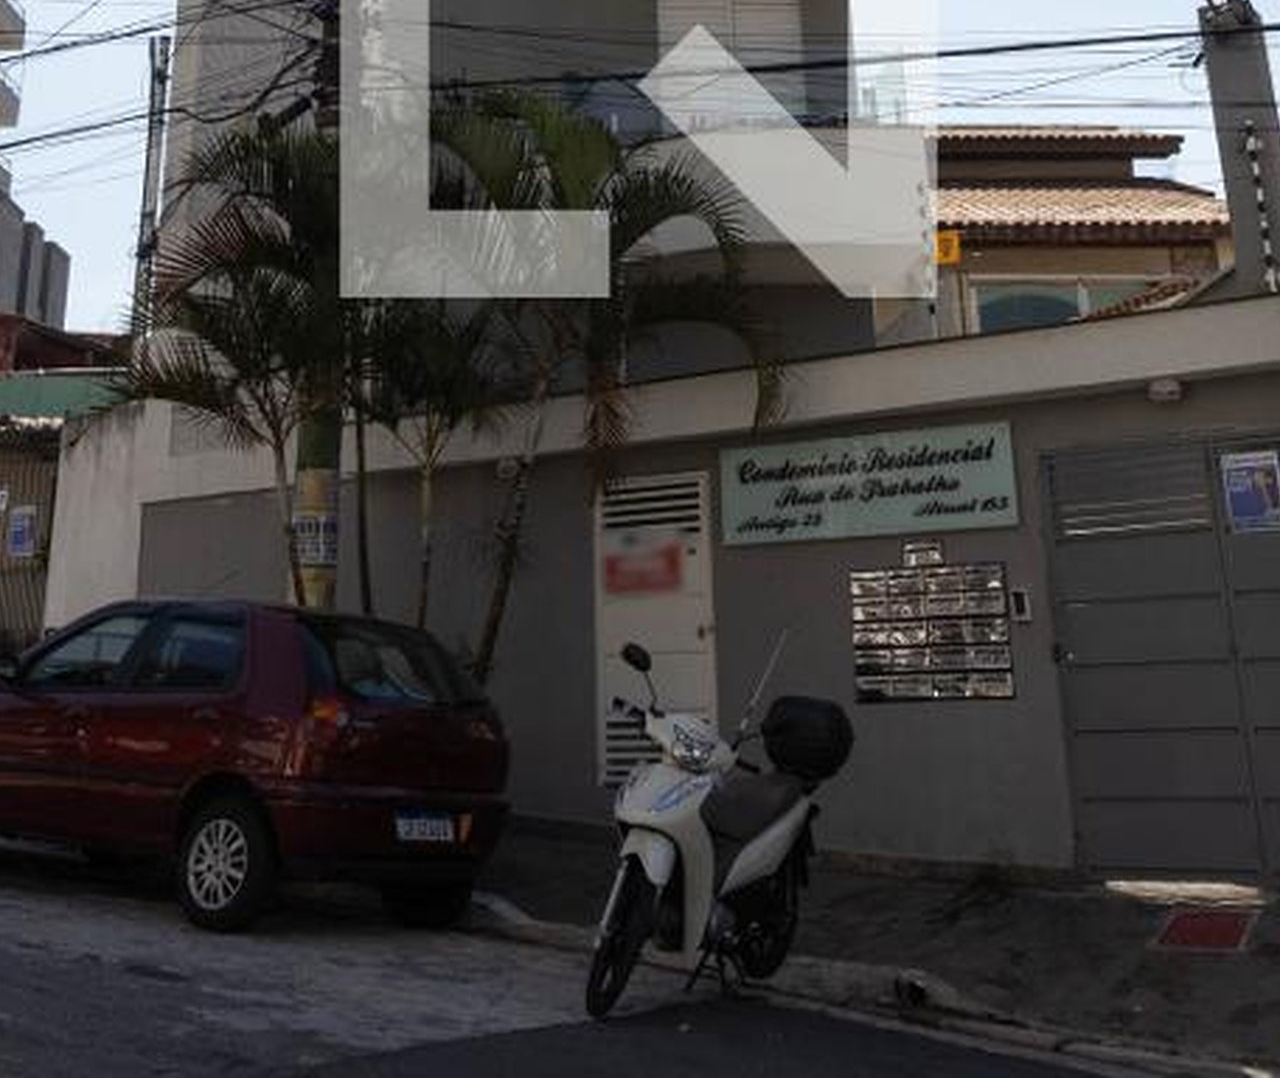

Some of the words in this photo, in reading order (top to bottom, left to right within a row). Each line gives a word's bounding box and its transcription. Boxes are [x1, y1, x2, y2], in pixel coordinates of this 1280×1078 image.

[861, 437, 995, 473] Residencial
[774, 485, 825, 508] Rua
[829, 484, 854, 502] do
